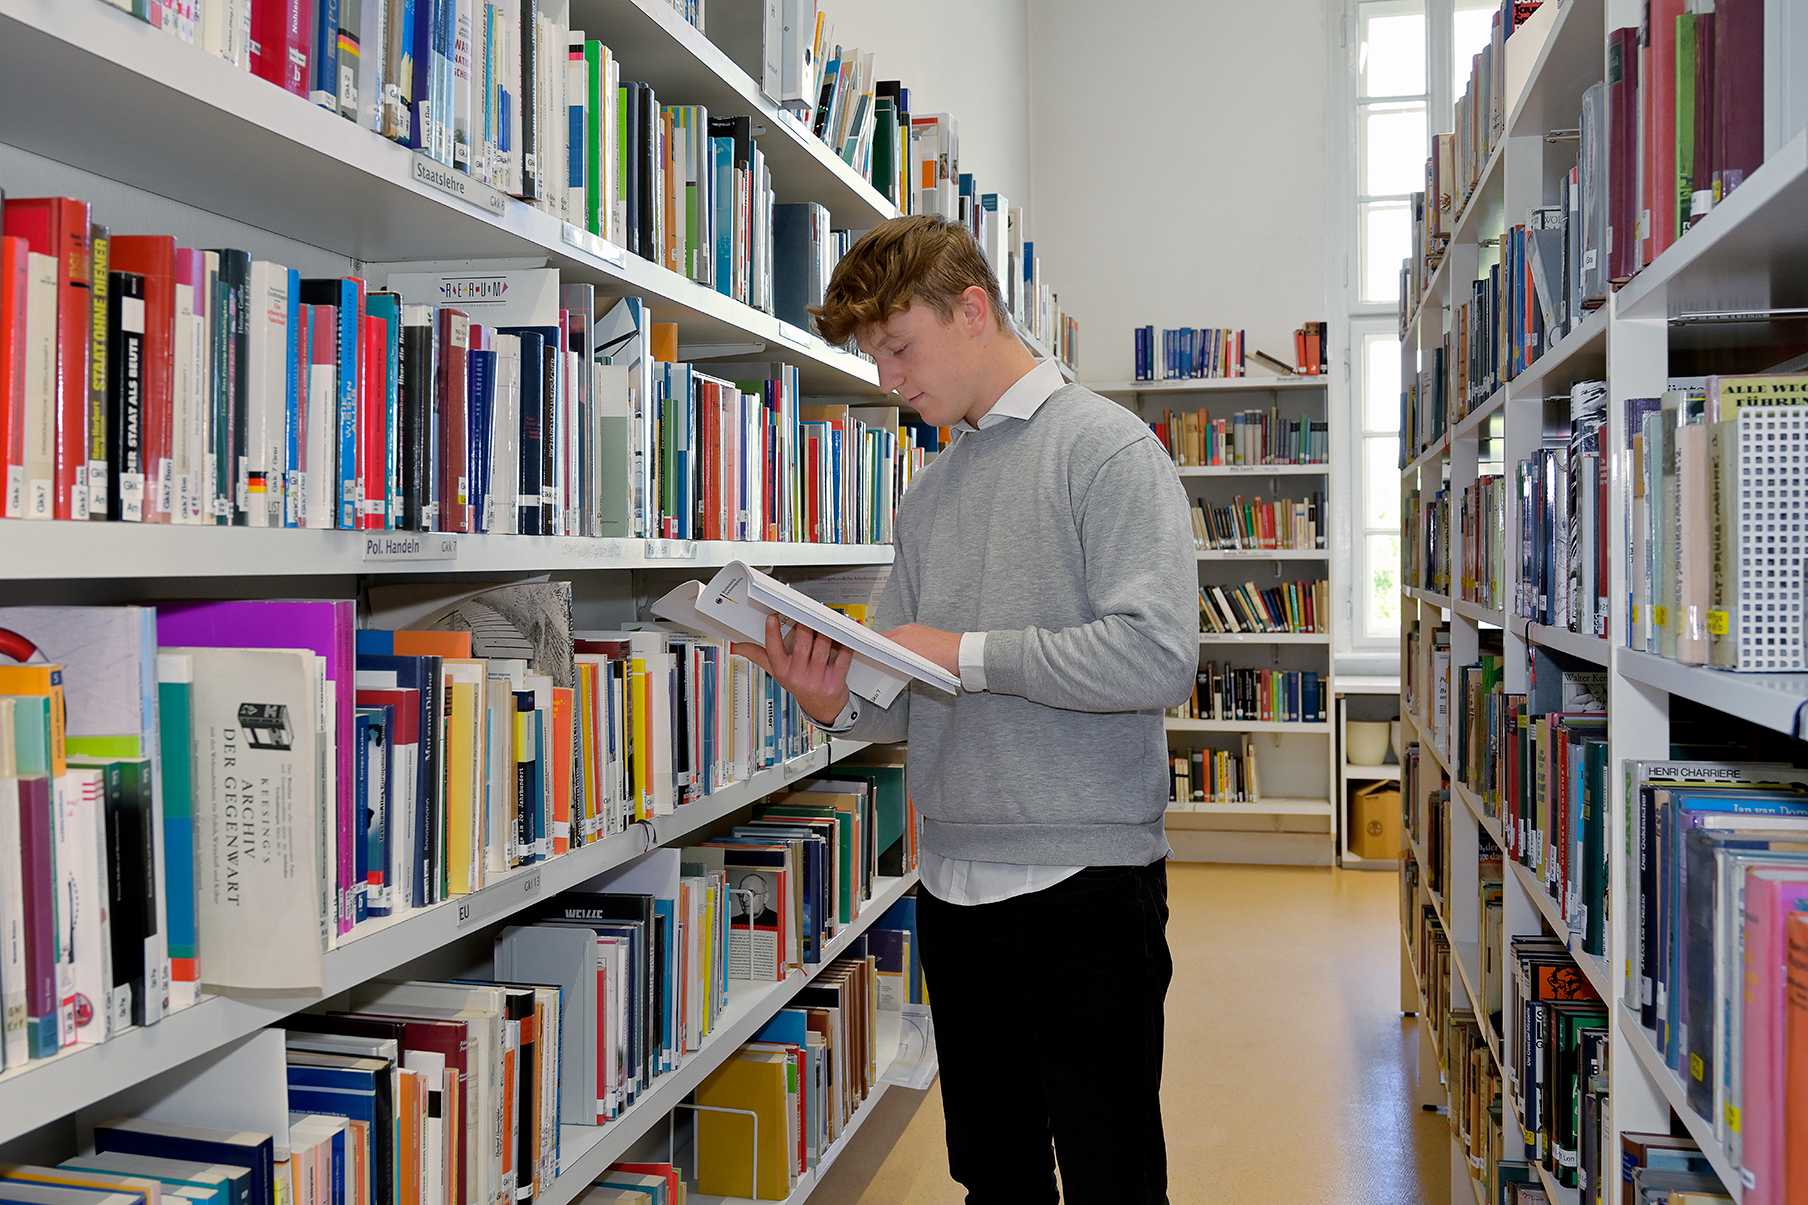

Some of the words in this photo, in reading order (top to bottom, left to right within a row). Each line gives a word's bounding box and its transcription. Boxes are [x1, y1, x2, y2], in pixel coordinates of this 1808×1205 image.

[417, 162, 465, 194] Staatslehre
[95, 238, 108, 296] DIENER
[93, 297, 107, 341] OHNE
[92, 342, 107, 391] STAAT
[128, 337, 139, 377] BEUTE
[128, 380, 138, 404] ALS
[1726, 384, 1768, 394] ALLE
[128, 407, 138, 447] STAAT
[366, 540, 383, 554] Pol.
[386, 538, 420, 553] Handeln
[1564, 672, 1587, 682] Walter
[424, 710, 433, 737] zum
[223, 728, 237, 768] DER
[424, 737, 433, 761] Mut
[1648, 767, 1679, 777] HENRI
[241, 779, 256, 860] ARCHIV
[260, 777, 271, 864] KEESING'S
[223, 776, 240, 908] GEGENWART
[459, 904, 470, 920] EU
